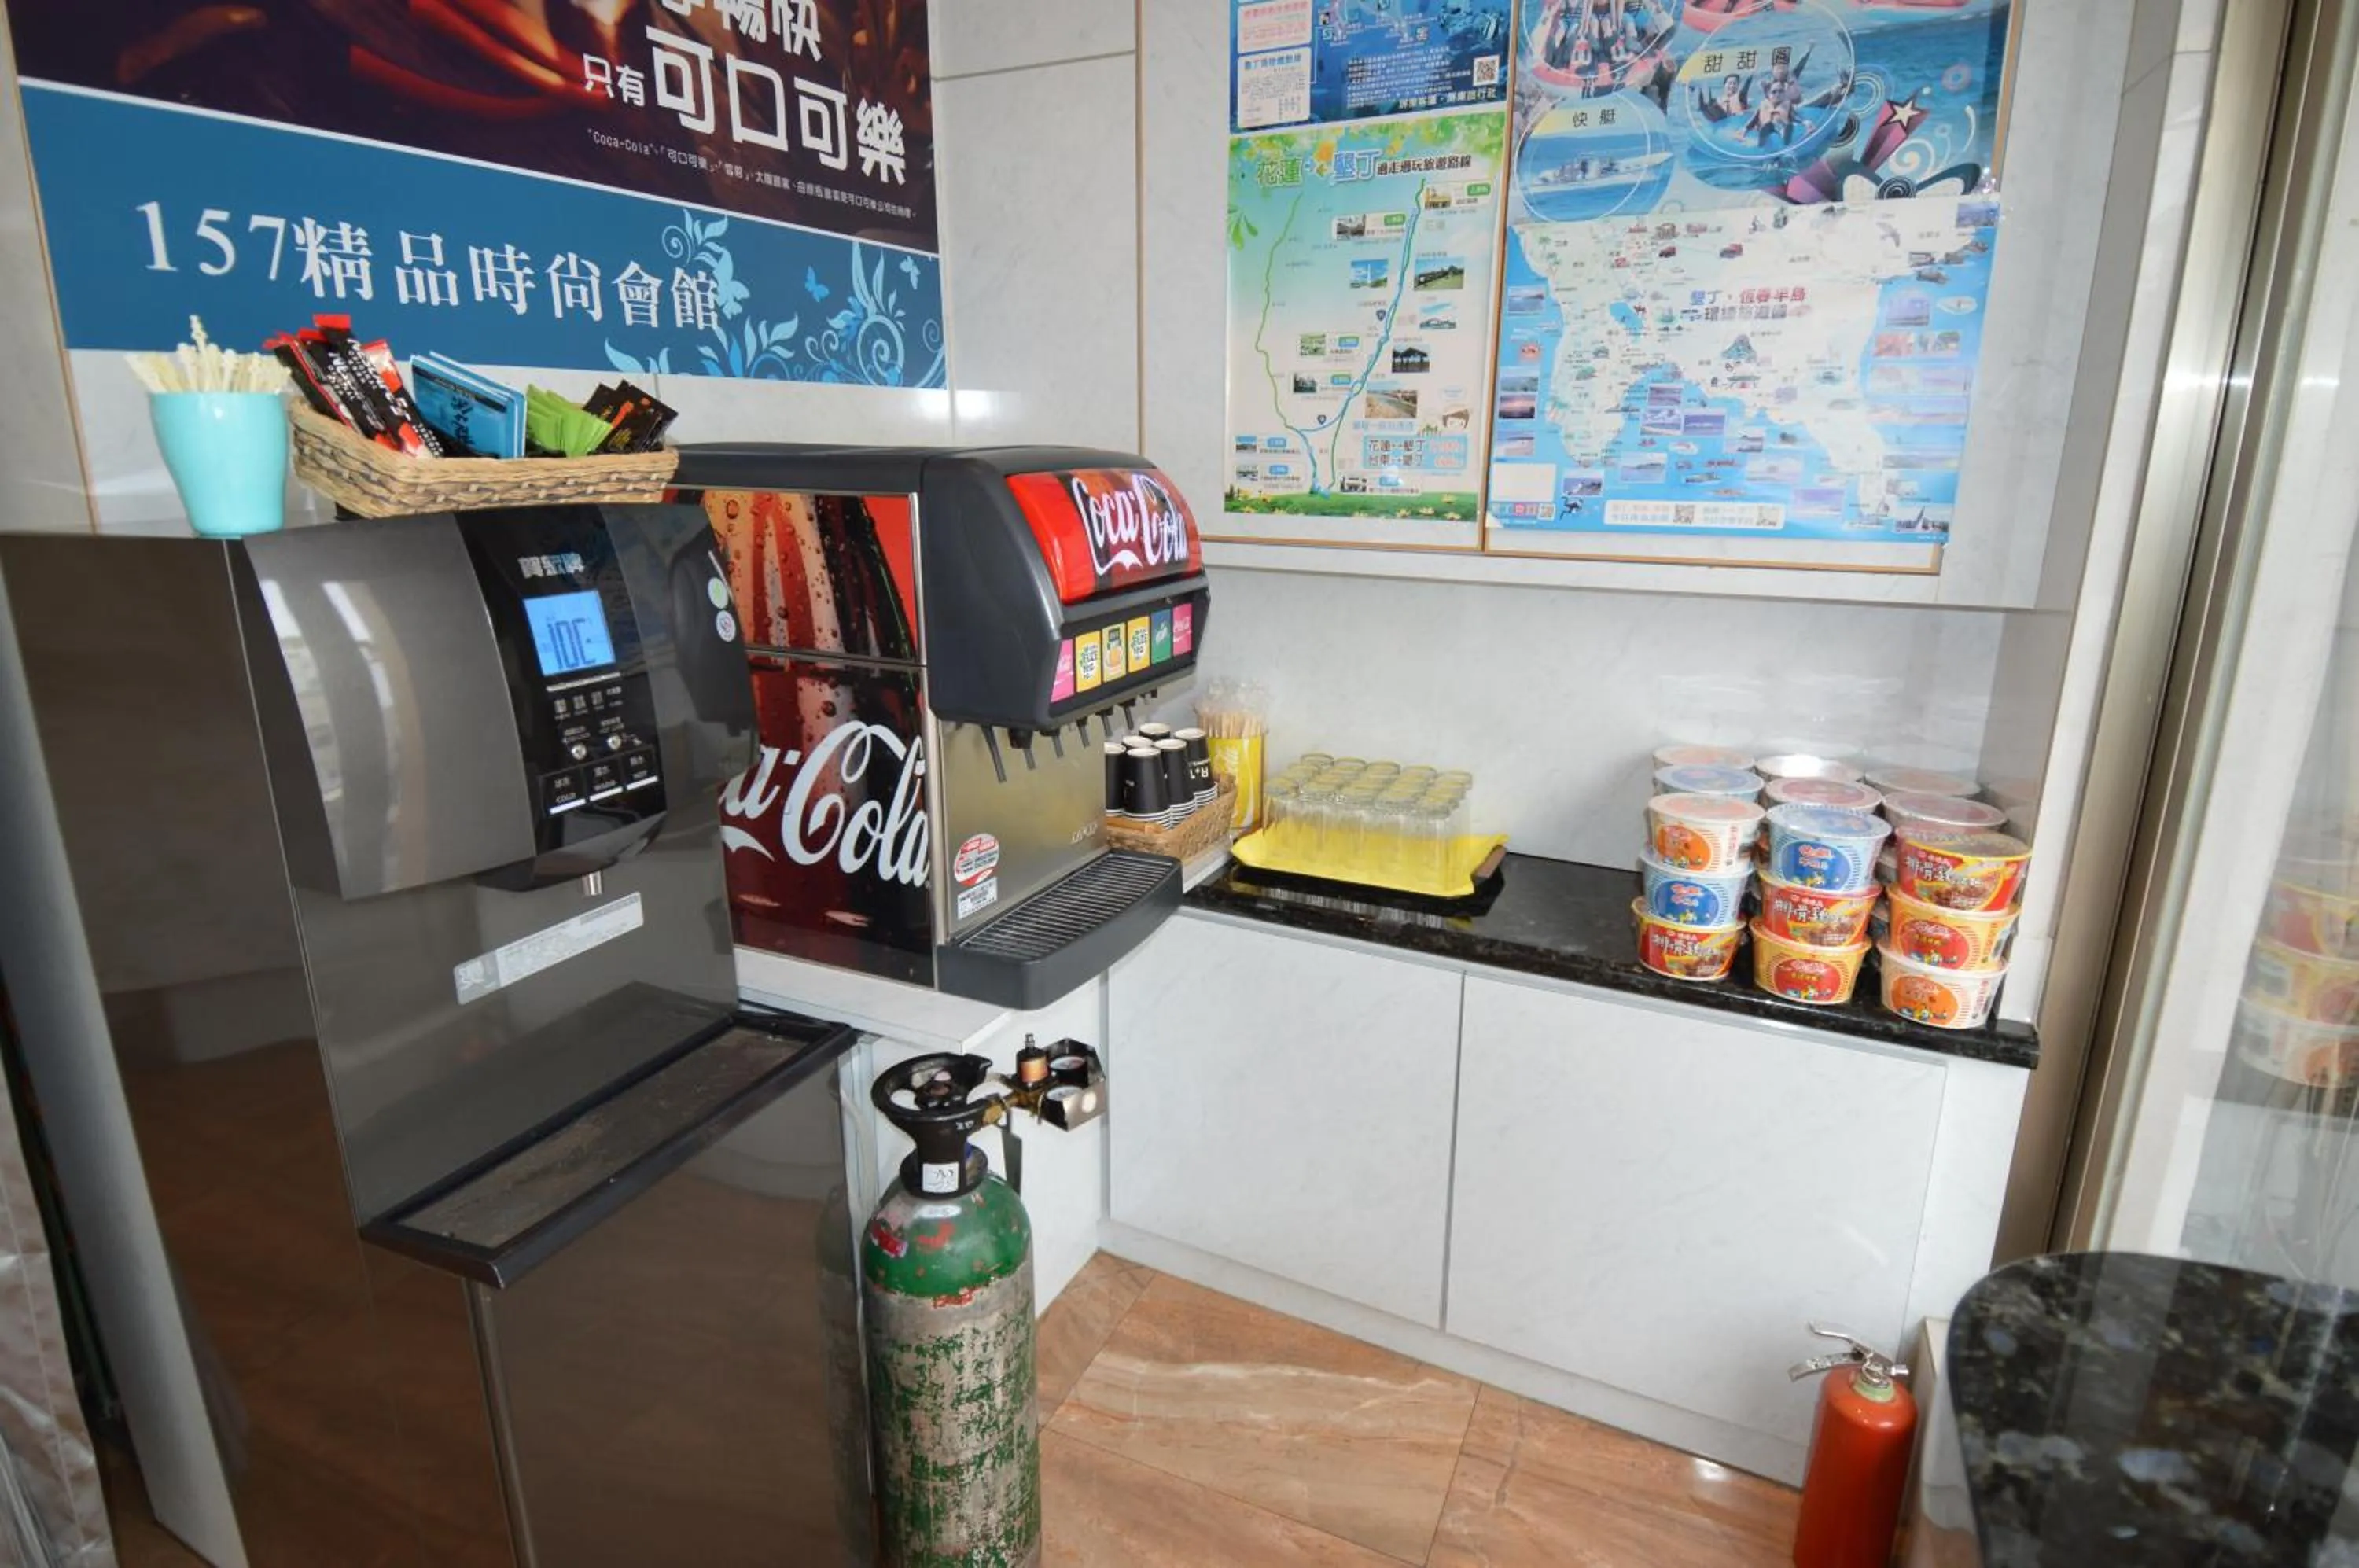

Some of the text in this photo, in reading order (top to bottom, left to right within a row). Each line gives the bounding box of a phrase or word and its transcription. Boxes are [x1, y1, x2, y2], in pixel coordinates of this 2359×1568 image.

[661, 0, 822, 62] 暢快
[1704, 46, 1791, 73] 甜甜圈
[646, 26, 906, 186] 可口可樂
[1573, 108, 1615, 127] 快艇
[1072, 473, 1189, 575] Coca-Cola
[719, 720, 931, 888] a-Cola
